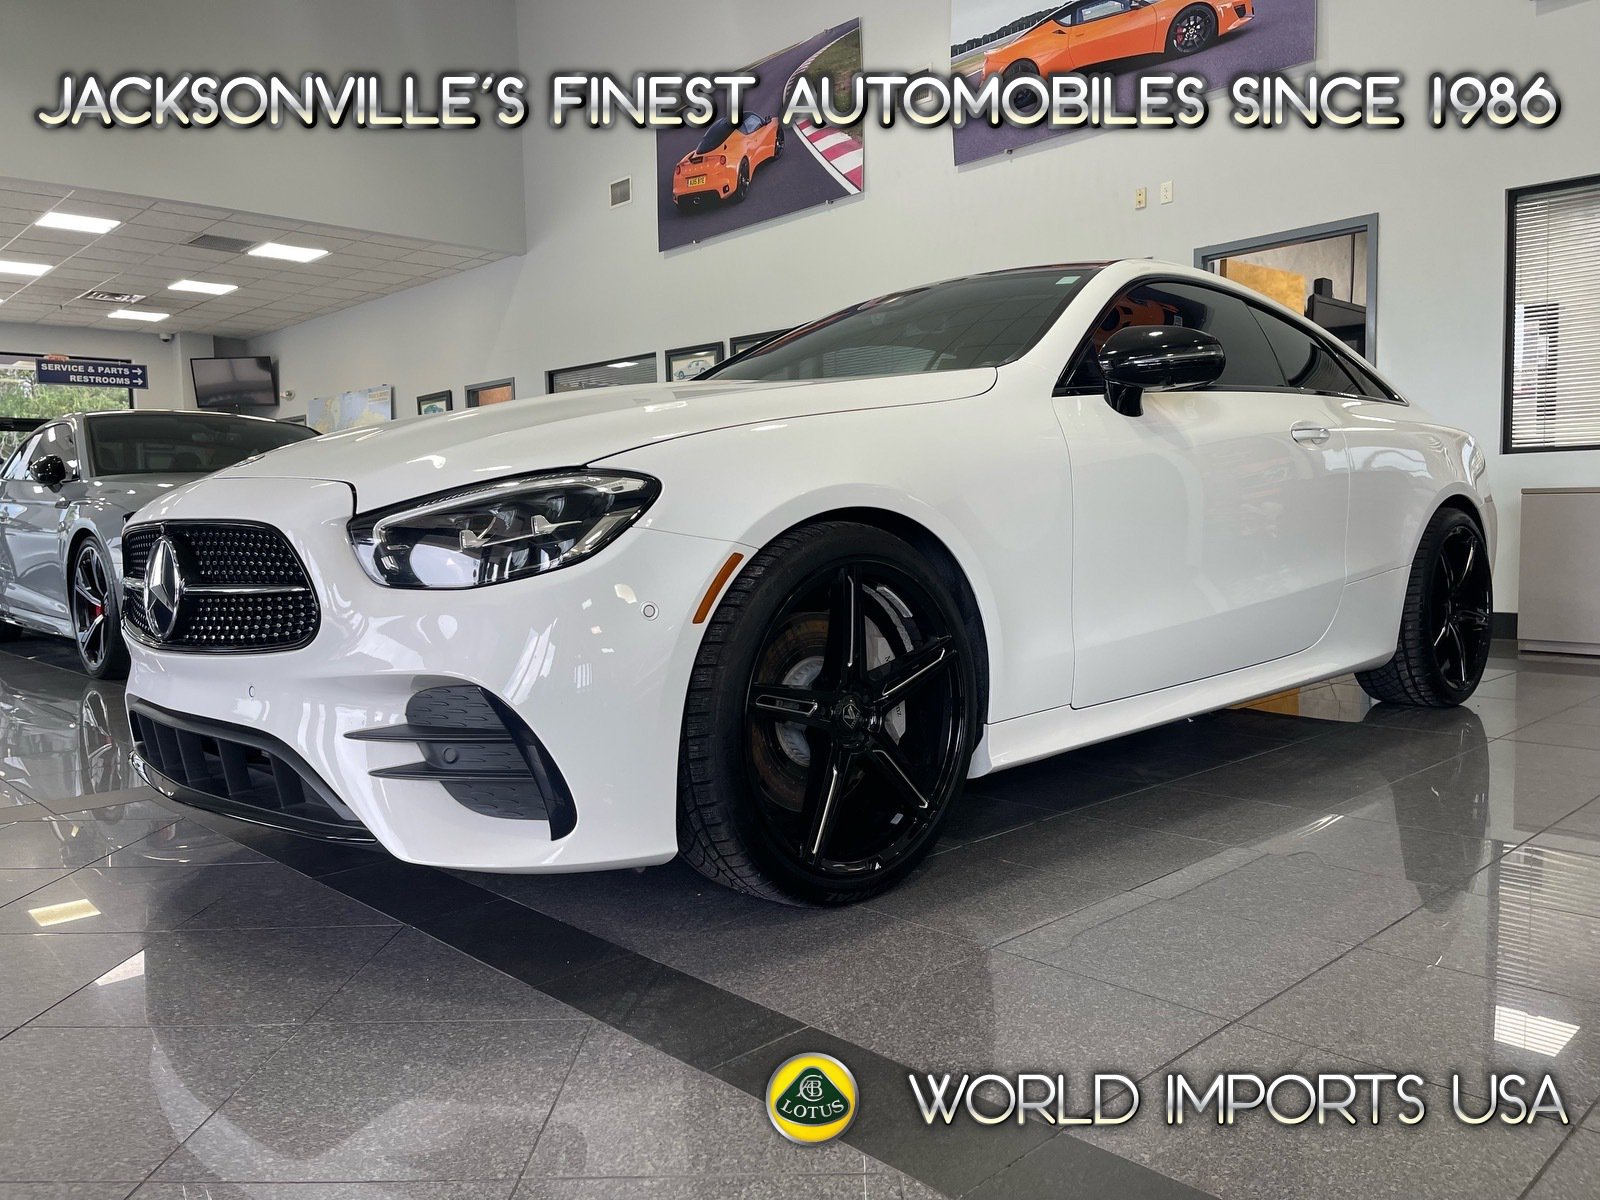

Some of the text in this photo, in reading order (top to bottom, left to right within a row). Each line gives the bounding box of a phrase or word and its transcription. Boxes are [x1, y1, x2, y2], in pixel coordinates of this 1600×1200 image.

[41, 363, 130, 375] SERVICE & PARTS
[69, 375, 131, 385] RESTROOMS
